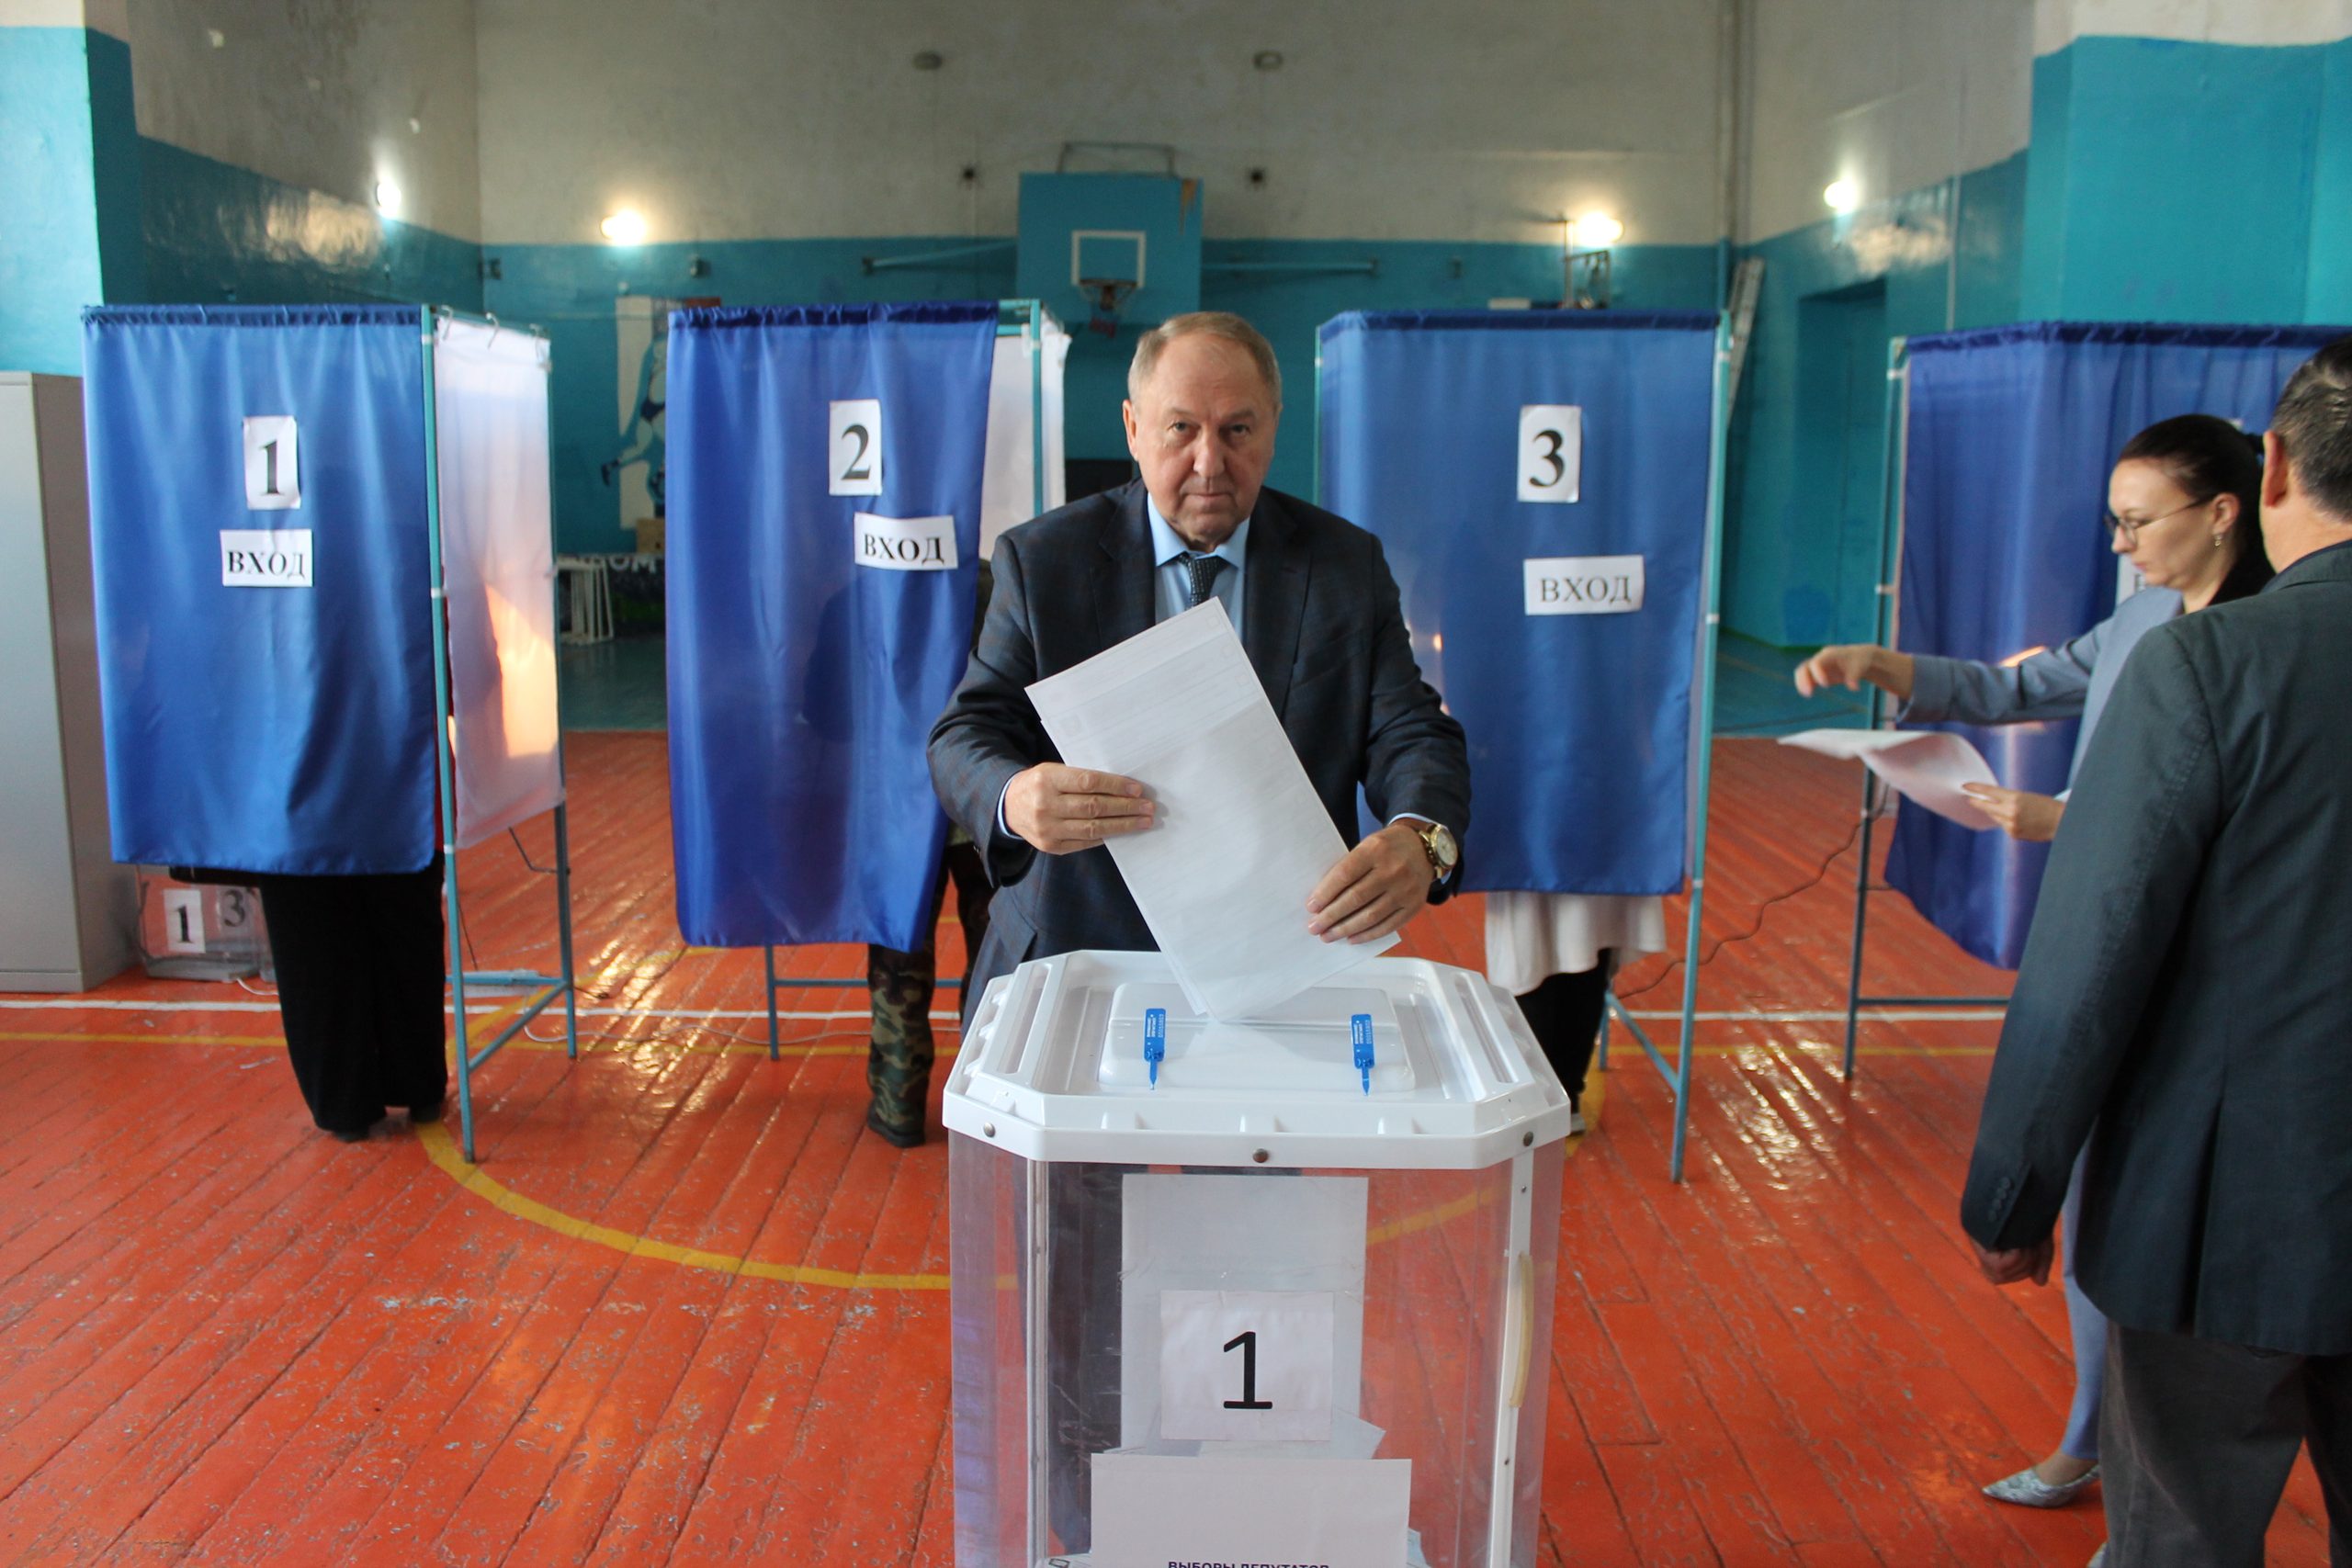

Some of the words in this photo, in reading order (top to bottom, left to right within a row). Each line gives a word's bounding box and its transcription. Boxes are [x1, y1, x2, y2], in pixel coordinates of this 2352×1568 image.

[259, 440, 285, 496] 1
[841, 423, 872, 481] 2
[1529, 429, 1566, 489] 3
[228, 551, 306, 580] ВХОД
[864, 533, 945, 566] ВХОД
[1540, 575, 1632, 604] ВХОД
[175, 905, 194, 943] 1
[223, 888, 246, 928] 3
[1222, 1330, 1274, 1410] 1
